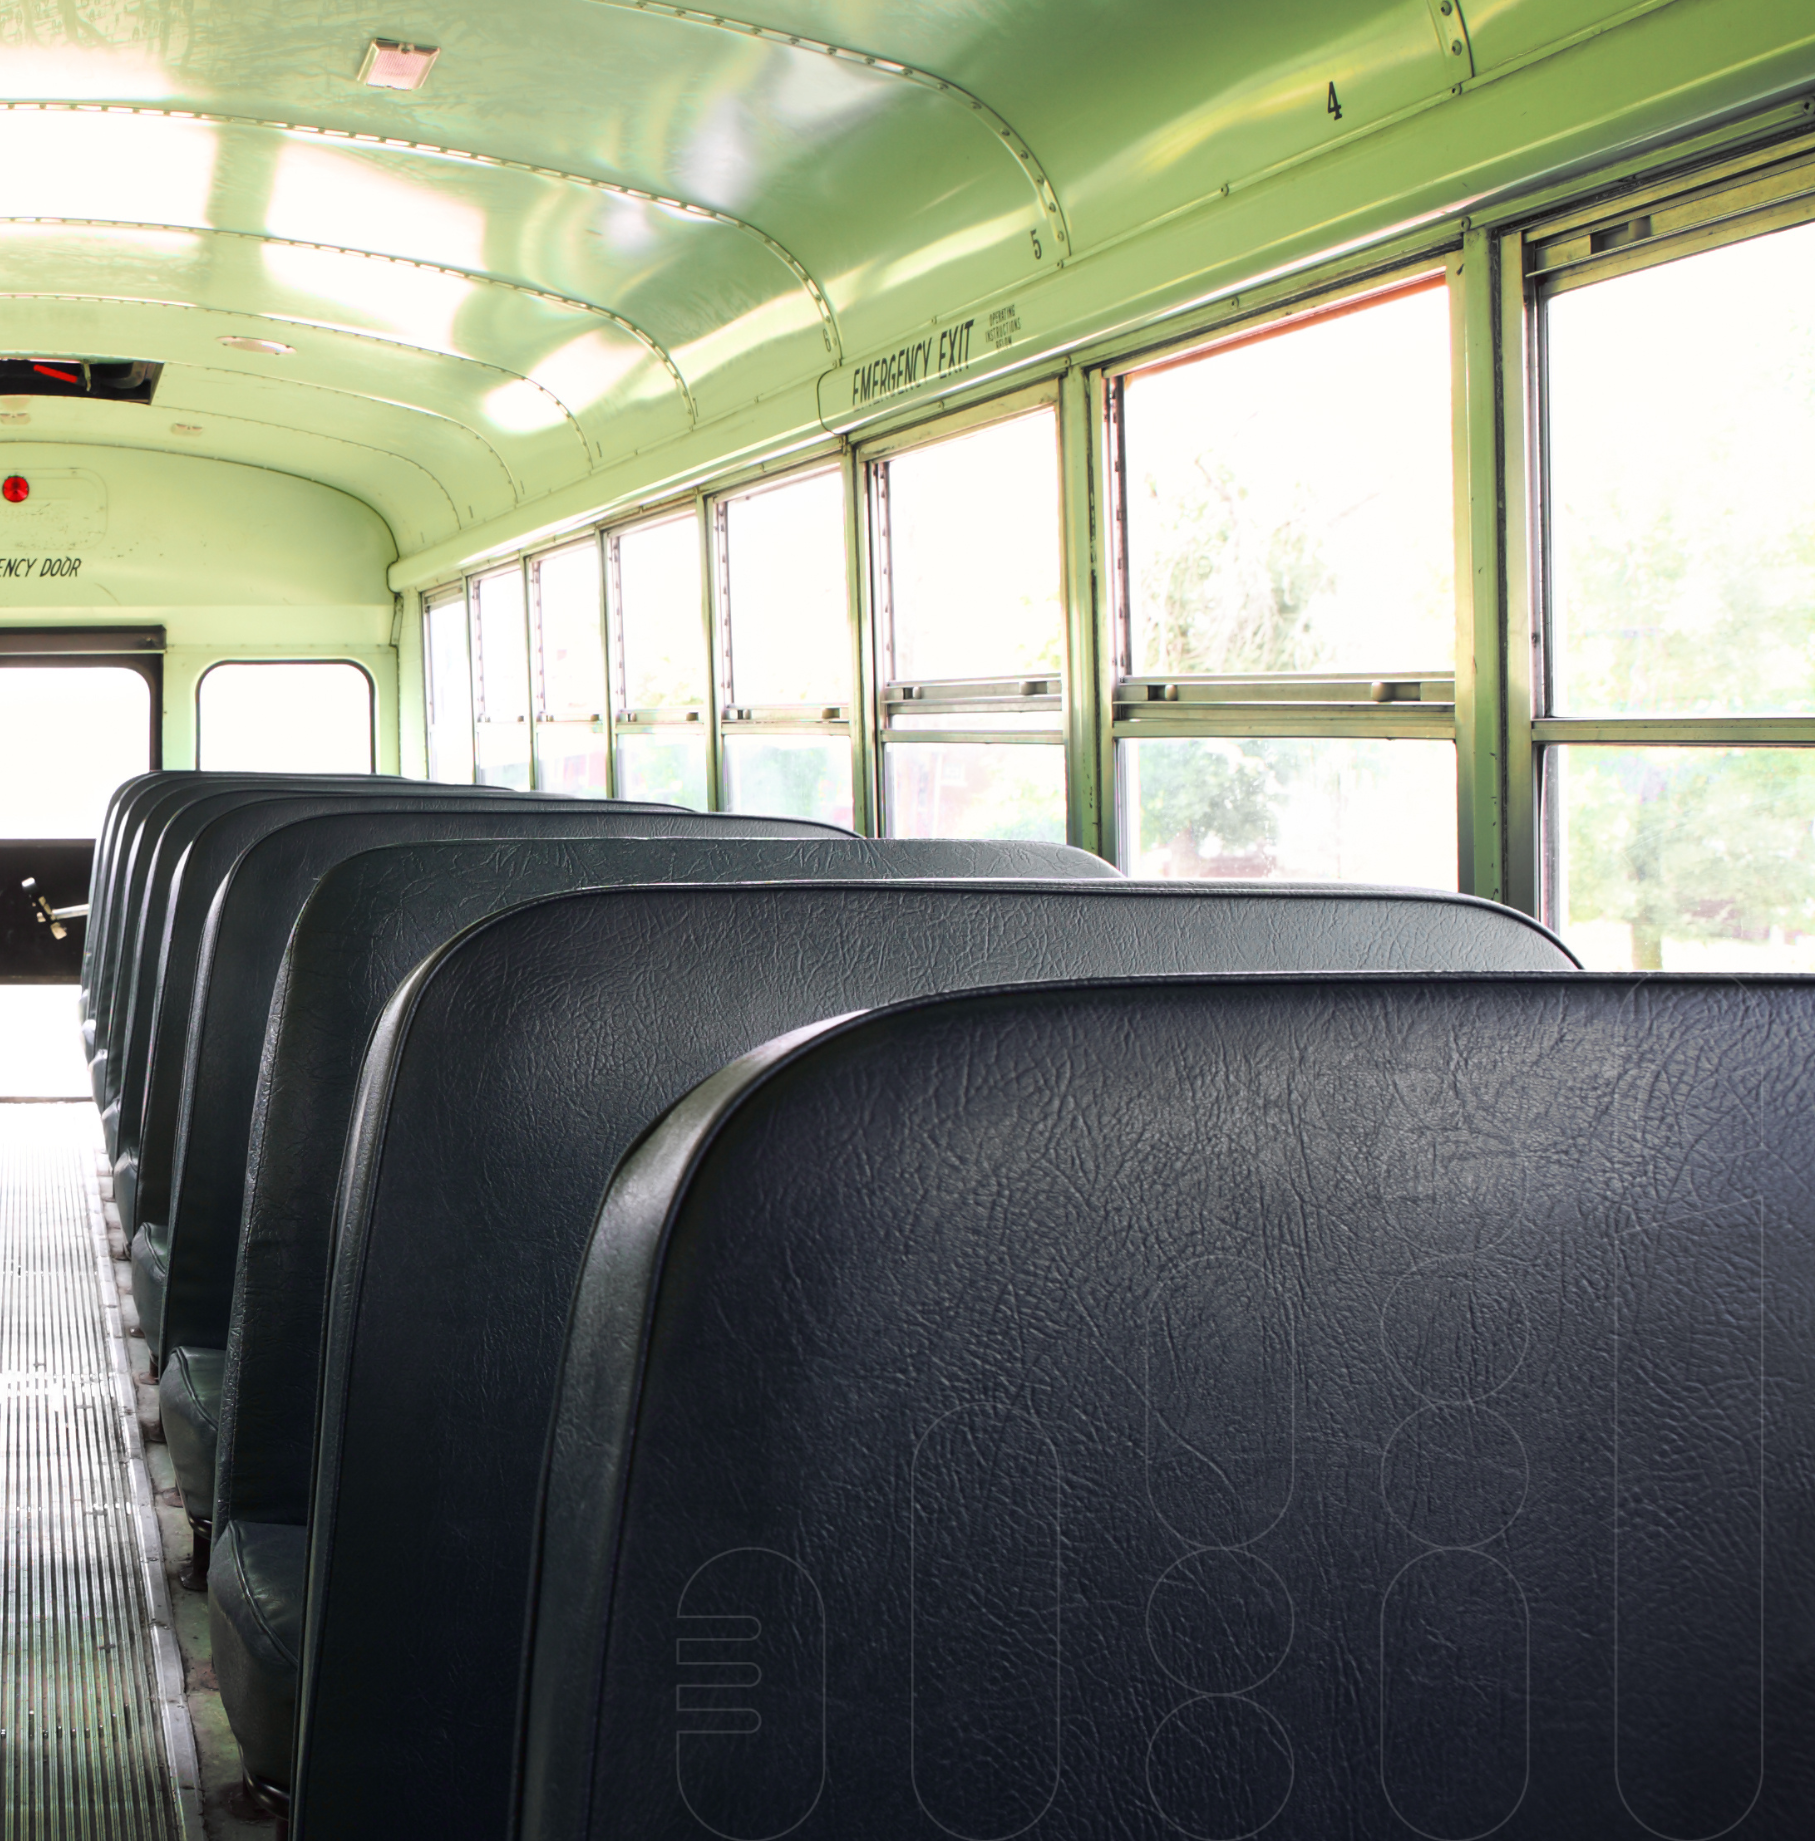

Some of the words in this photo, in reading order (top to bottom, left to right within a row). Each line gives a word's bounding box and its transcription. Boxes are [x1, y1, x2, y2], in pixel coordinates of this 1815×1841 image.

[1327, 81, 1343, 121] 4
[1030, 228, 1042, 260] 5
[852, 336, 933, 413] EMERGENCY
[938, 319, 975, 379] EXIT
[39, 557, 82, 578] DOOR
